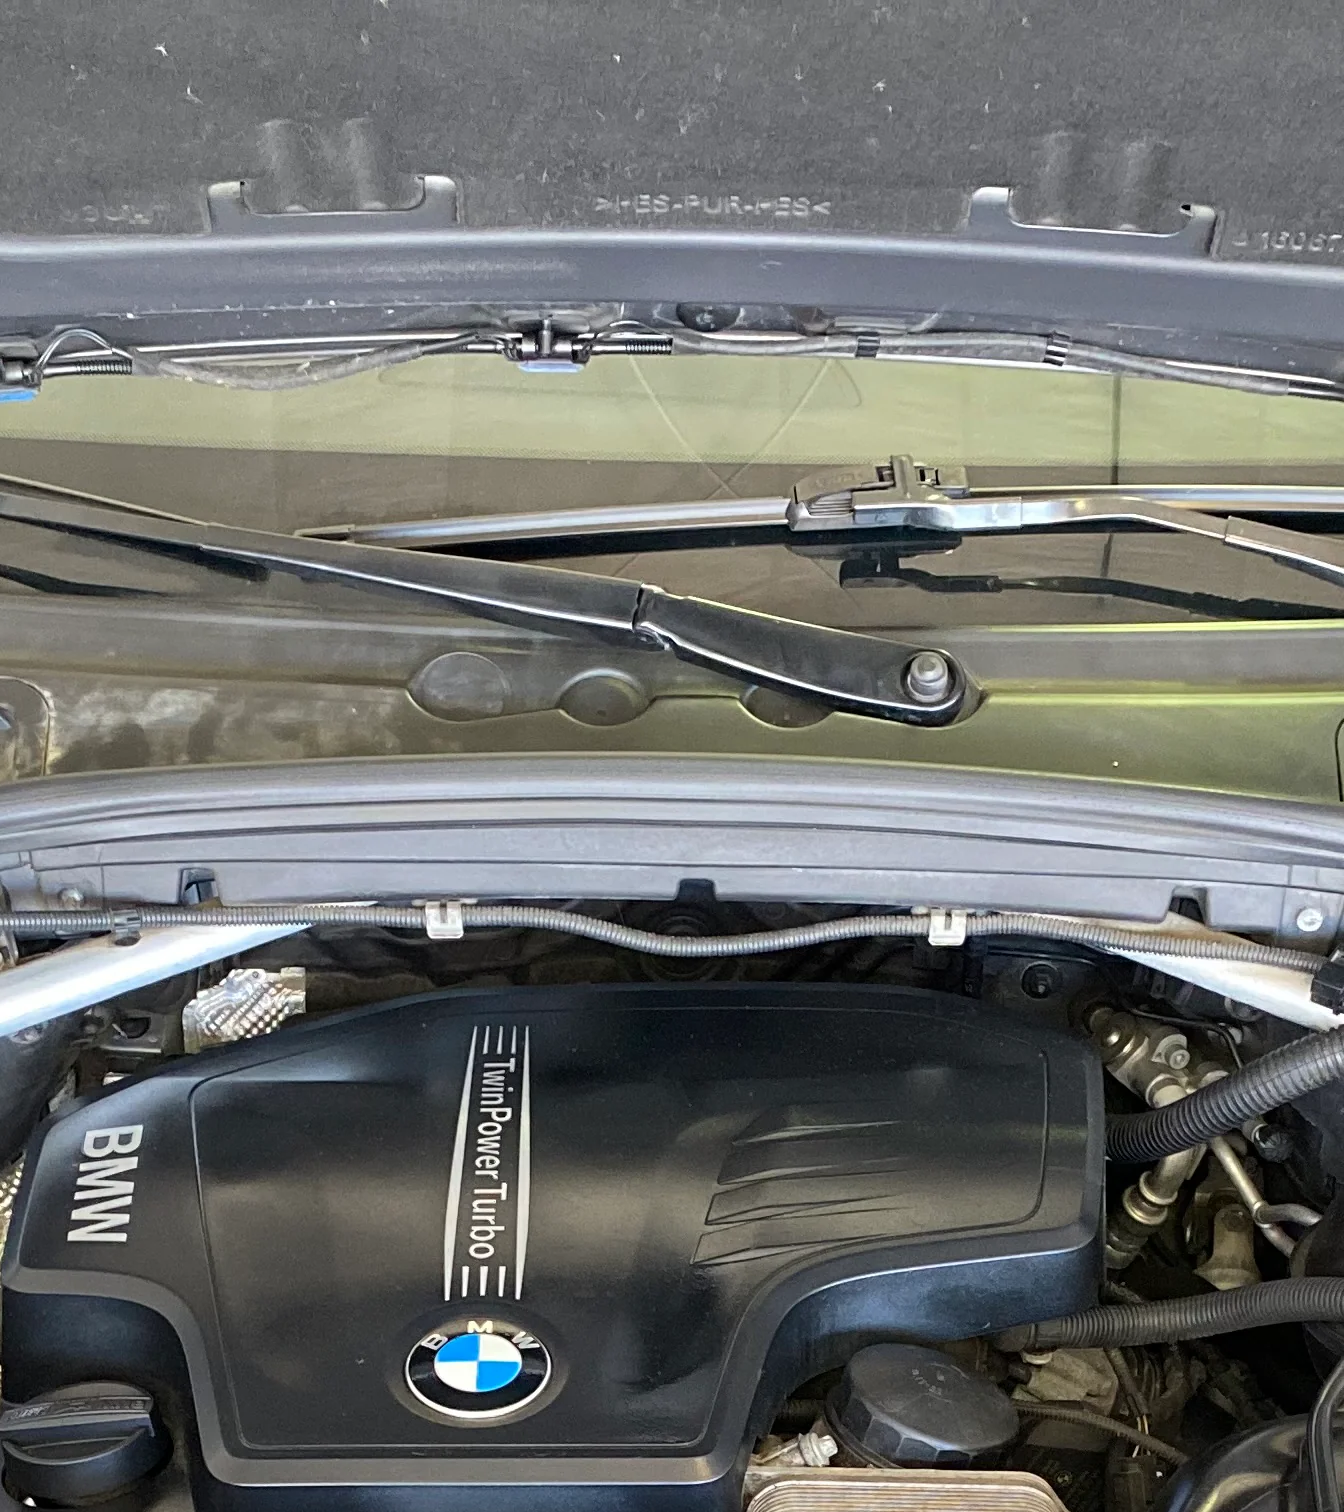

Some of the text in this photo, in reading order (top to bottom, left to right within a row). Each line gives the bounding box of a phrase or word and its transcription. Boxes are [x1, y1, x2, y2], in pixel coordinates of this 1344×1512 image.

[66, 1123, 143, 1243] BMW
[468, 1057, 517, 1260] TwinPower Turbo
[420, 1319, 540, 1352] BMW
